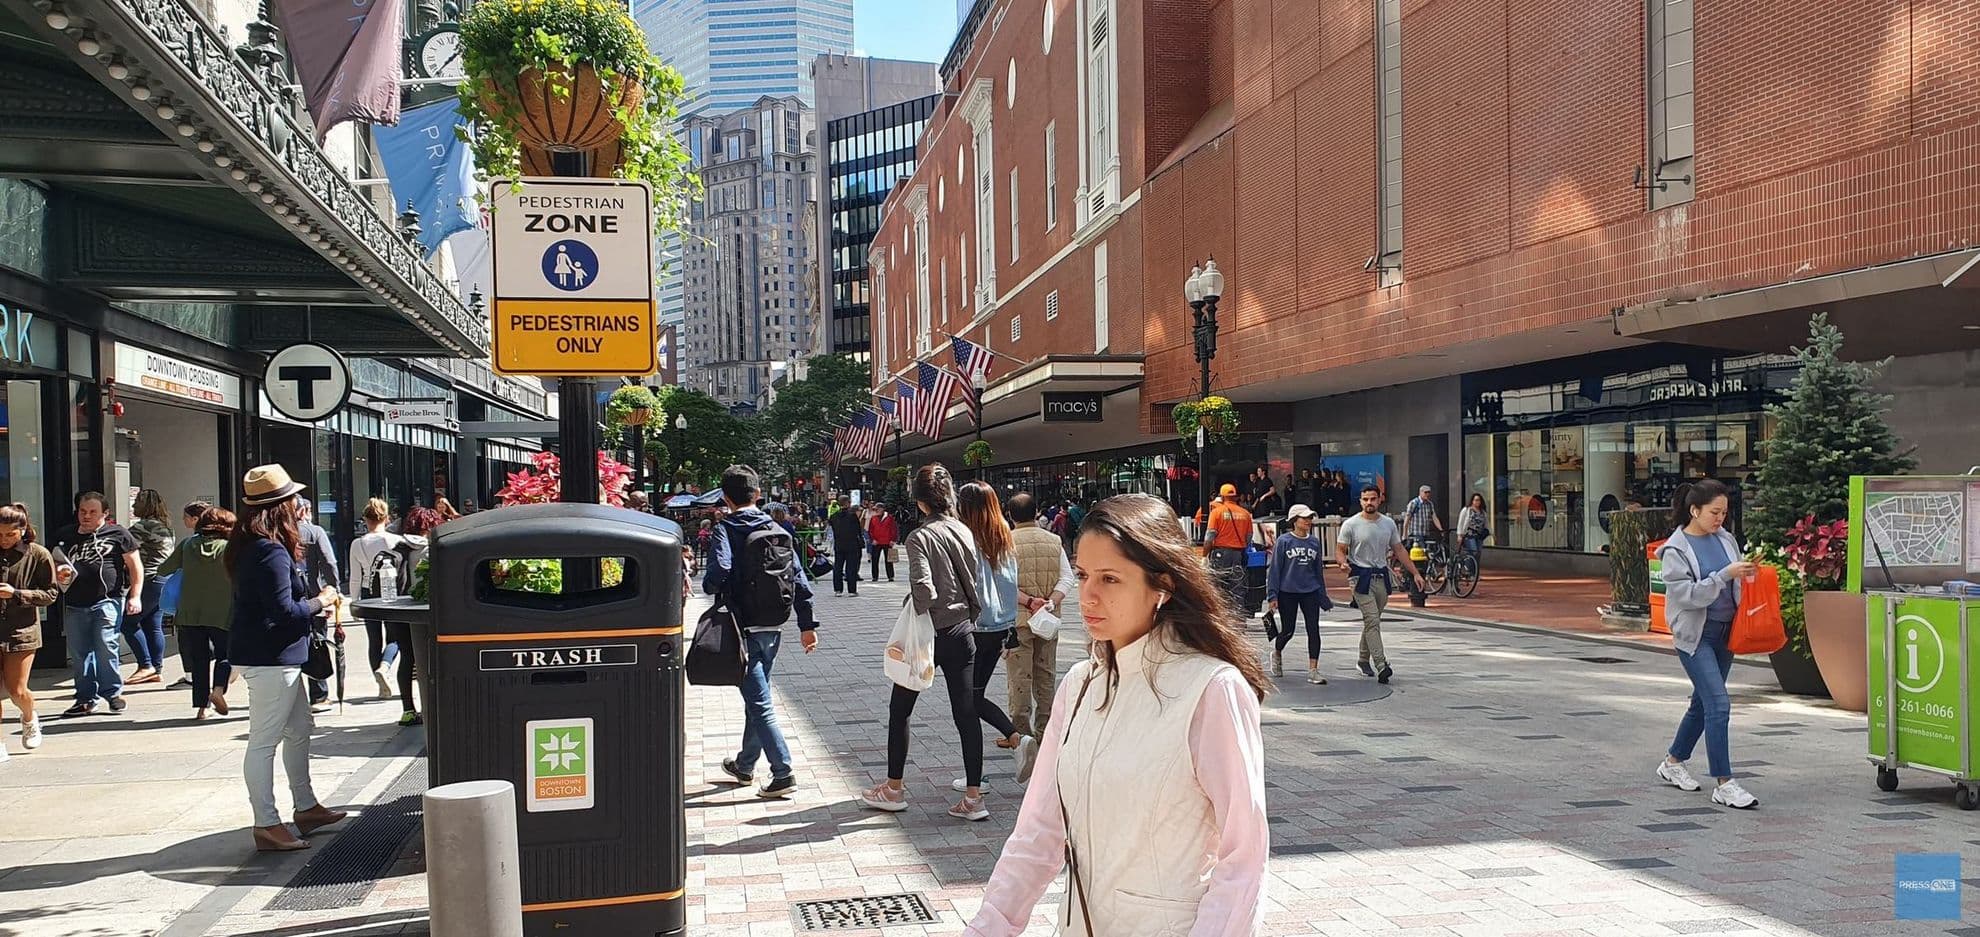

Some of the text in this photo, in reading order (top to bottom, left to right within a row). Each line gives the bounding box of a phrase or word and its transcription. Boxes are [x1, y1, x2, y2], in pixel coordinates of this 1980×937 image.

[519, 196, 624, 209] PEDESTRIAN
[524, 214, 618, 233] ZONE
[511, 315, 640, 332] PEDESTRIANS
[556, 337, 603, 354] ONLY
[147, 355, 219, 388] DOWNTOWN CROSSING
[279, 366, 331, 409] T
[1286, 547, 1306, 559] CAPE
[513, 648, 602, 667] TRASH
[1876, 695, 1954, 719] 6-261-0066
[540, 779, 581, 787] DOWNTOWN
[540, 786, 582, 796] BOSTON
